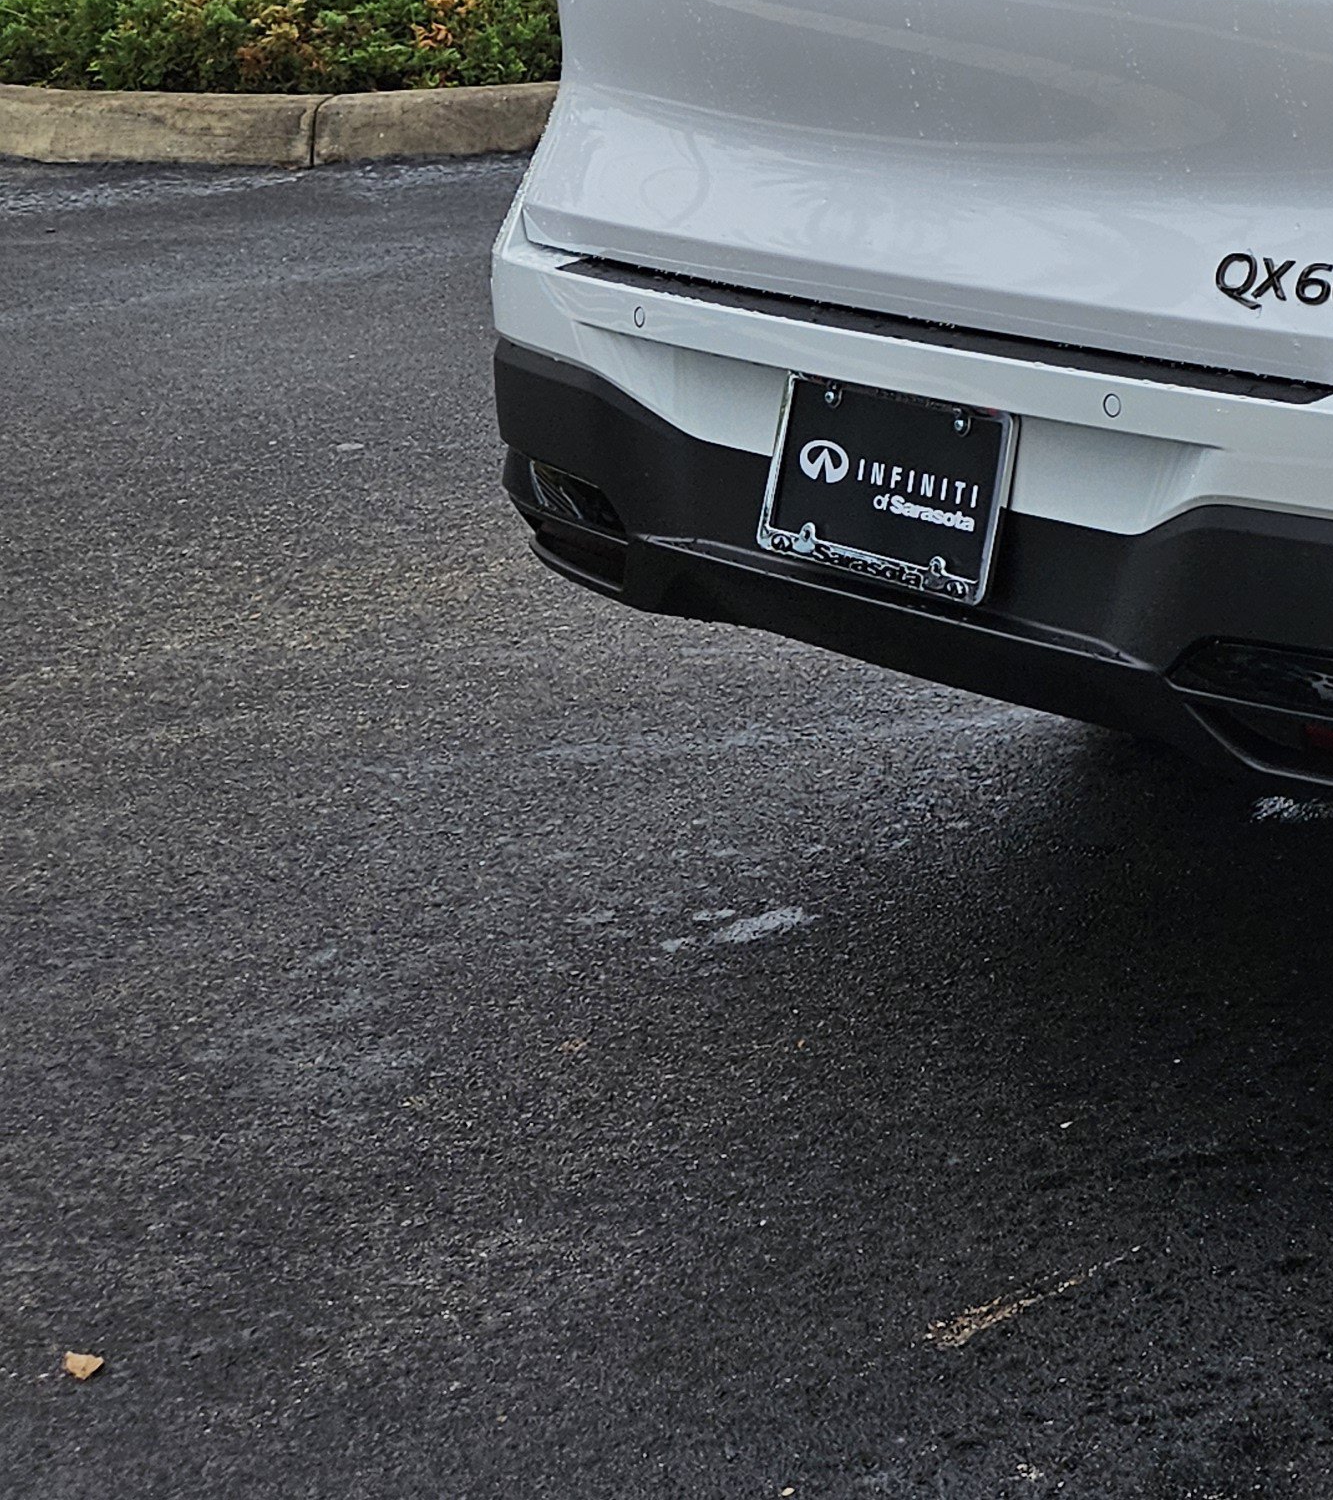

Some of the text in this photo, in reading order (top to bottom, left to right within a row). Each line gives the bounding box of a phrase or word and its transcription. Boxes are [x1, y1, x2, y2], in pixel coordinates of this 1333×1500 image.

[857, 458, 979, 508] INFINITI
[873, 493, 975, 533] of Sarasota
[811, 542, 925, 591] Sarasota
